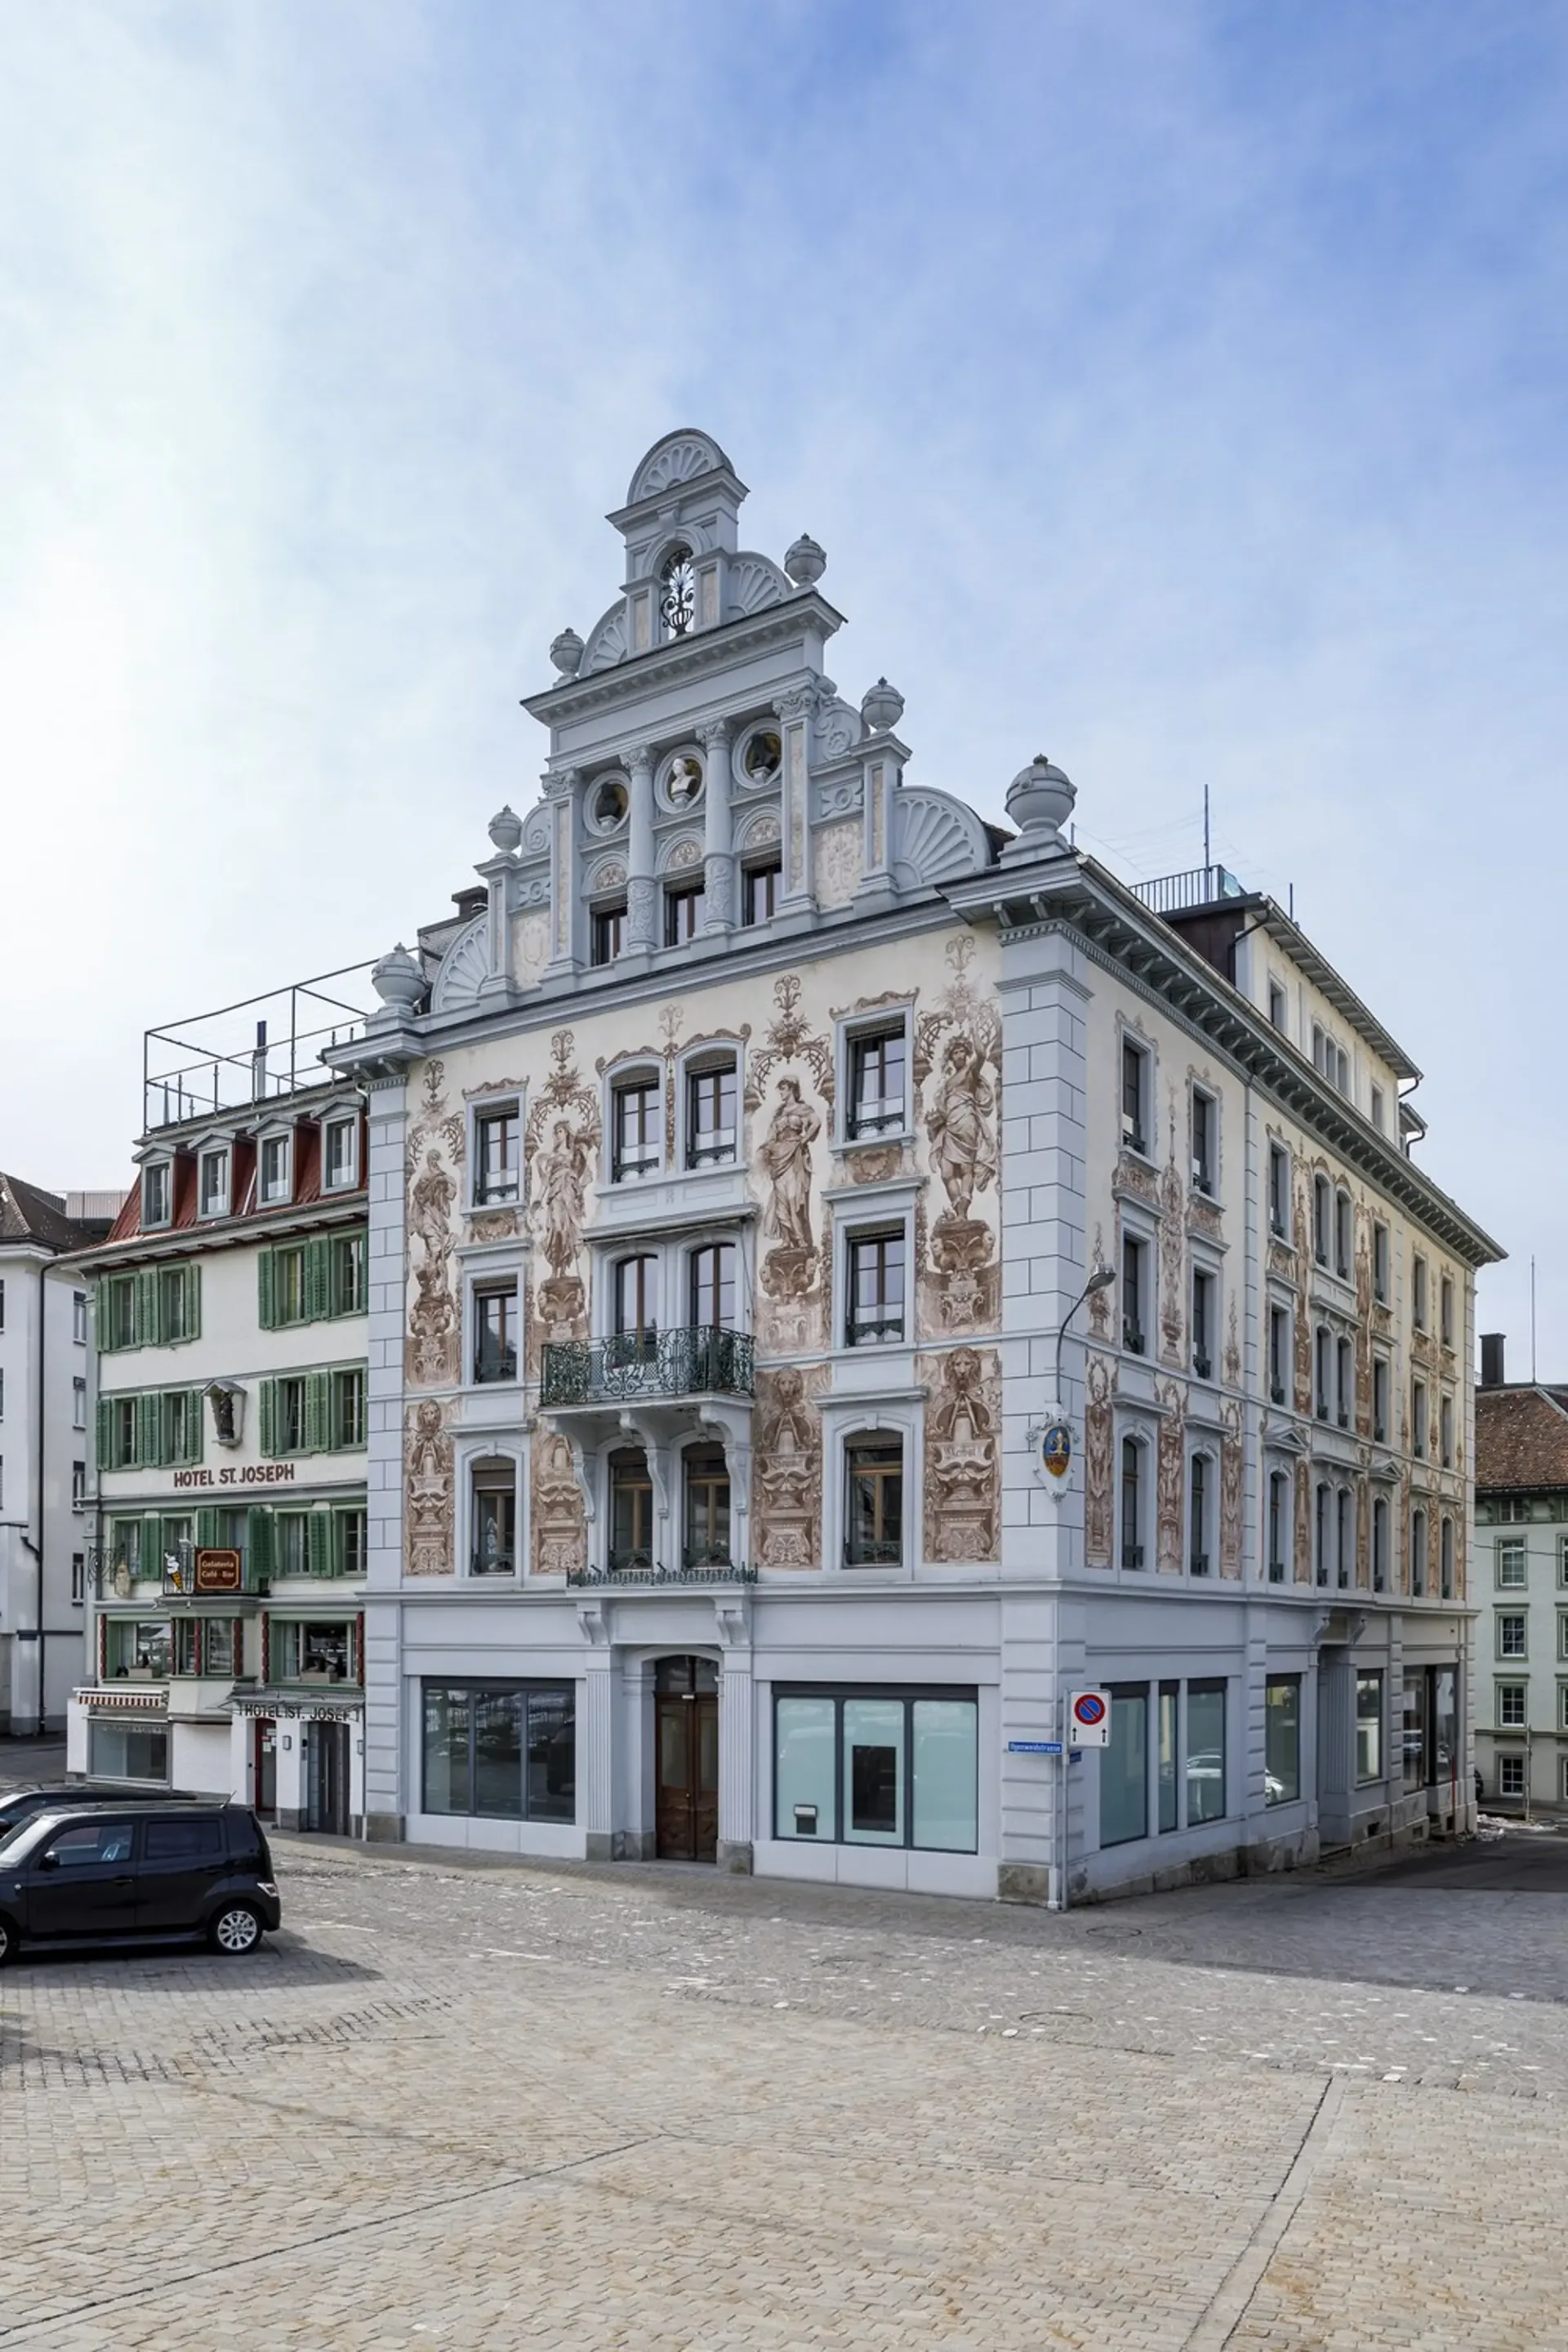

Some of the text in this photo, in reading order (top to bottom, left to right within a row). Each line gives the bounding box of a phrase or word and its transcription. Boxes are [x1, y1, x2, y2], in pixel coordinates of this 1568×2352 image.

[174, 1463, 295, 1488] HOTEL ST. JOSEPH
[202, 1560, 234, 1568] Gelateria
[222, 1570, 234, 1579] Bar
[245, 1704, 282, 1717] HOTEL
[287, 1705, 305, 1719] ST.
